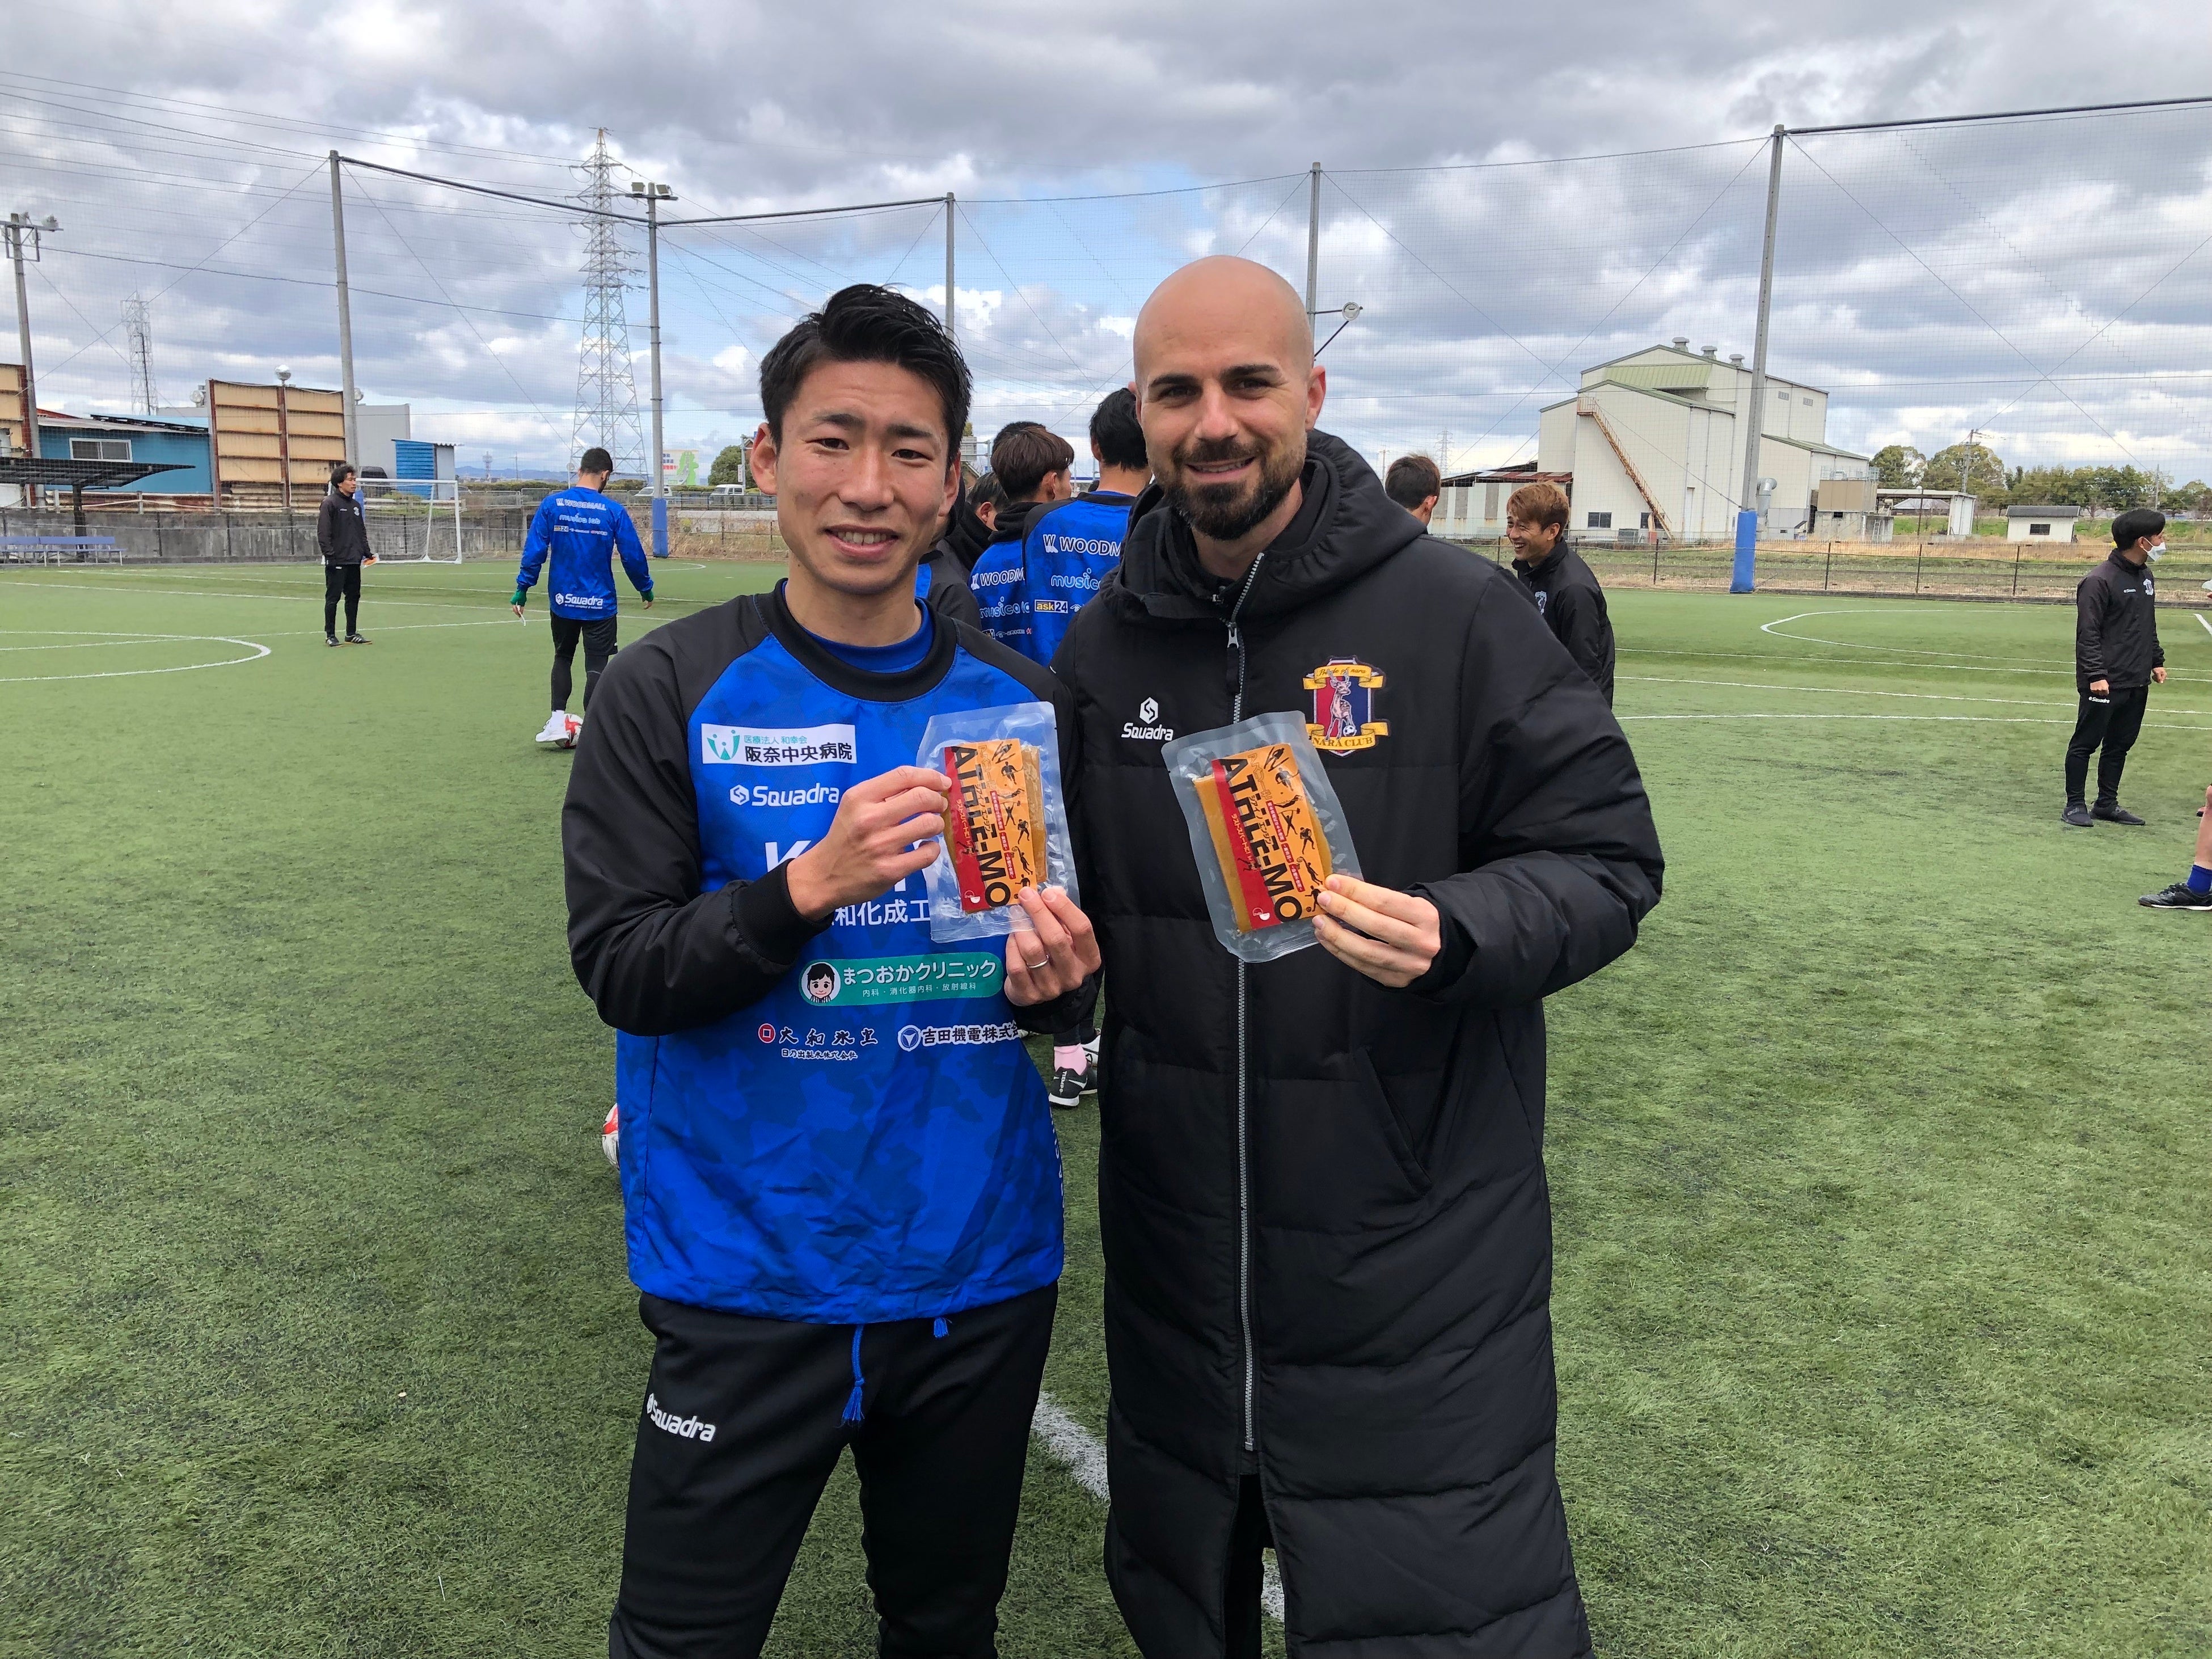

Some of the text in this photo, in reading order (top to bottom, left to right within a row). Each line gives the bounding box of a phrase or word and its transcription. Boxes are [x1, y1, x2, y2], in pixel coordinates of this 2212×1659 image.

[564, 593, 603, 606] Squadra
[744, 735, 779, 745] 医療法人
[1121, 722, 1173, 741] Squadra
[1312, 737, 1373, 747] NARA CLUB
[745, 742, 852, 763] 阪奈中央病院
[752, 783, 839, 807] Squadra
[831, 899, 931, 926] 和化成工
[843, 960, 997, 985] まつおかクリニック
[651, 1400, 716, 1442] Squadra
